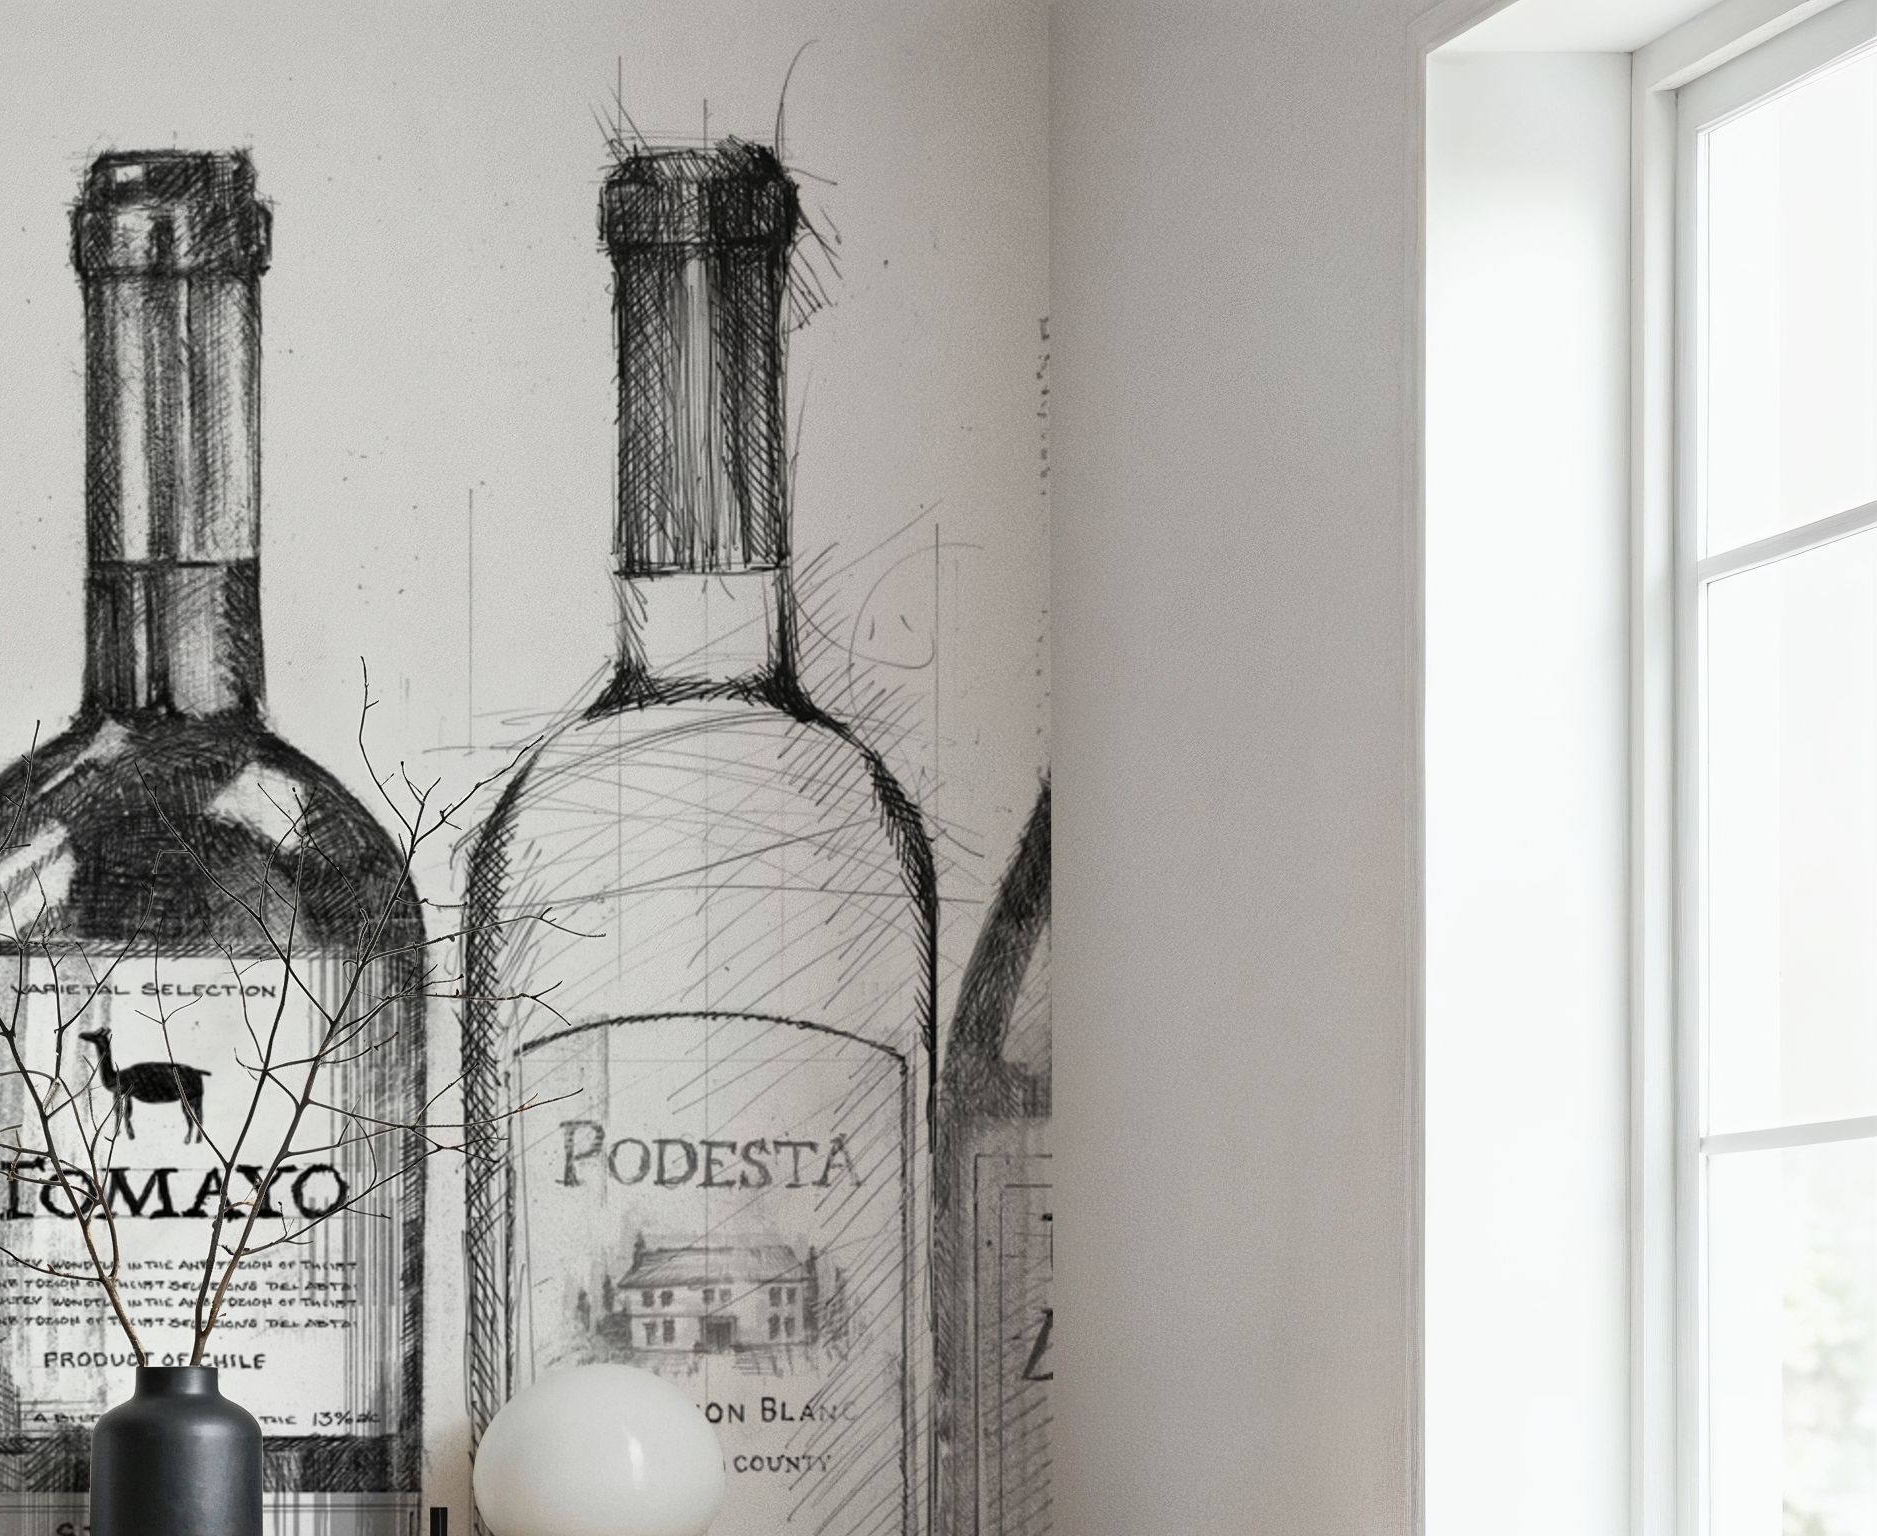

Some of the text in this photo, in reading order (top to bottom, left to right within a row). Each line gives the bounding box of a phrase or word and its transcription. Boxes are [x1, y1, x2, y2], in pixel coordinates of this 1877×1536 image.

[10, 982, 277, 998] VARIETAL SELECTION
[556, 1119, 864, 1189] PODESTA
[162, 1353, 189, 1367] OF
[199, 1353, 266, 1369] CHILE
[733, 1454, 832, 1474] COUNTY
